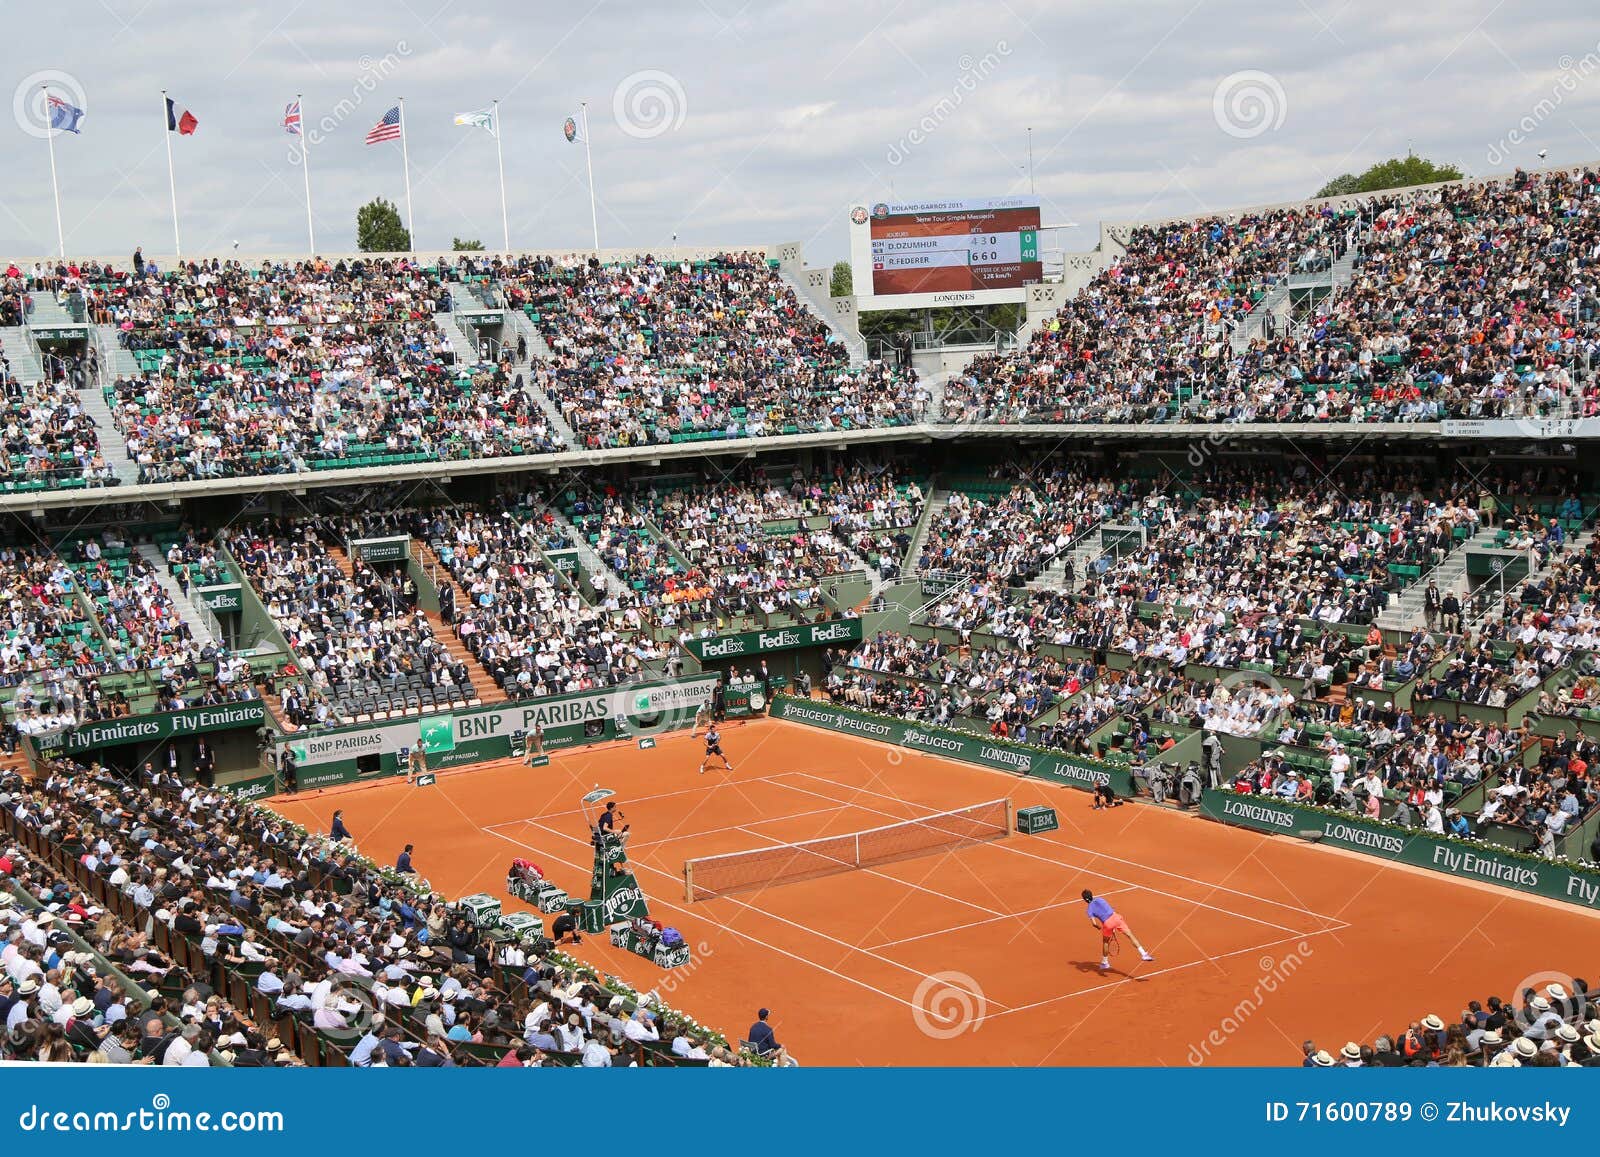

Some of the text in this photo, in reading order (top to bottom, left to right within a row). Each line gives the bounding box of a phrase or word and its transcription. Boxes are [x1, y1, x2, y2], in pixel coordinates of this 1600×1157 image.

[1025, 234, 1032, 243] 0
[889, 256, 929, 265] R.FEDERER
[972, 252, 978, 261] 6
[982, 252, 988, 260] 6
[991, 251, 997, 260] 0
[1022, 249, 1035, 258] 40
[934, 293, 975, 302] LONGINES
[702, 624, 852, 656] FedEx FedEx FedEx
[651, 691, 670, 702] BNP
[673, 685, 711, 699] PARIBAS
[727, 683, 761, 691] LONGINES
[172, 706, 264, 730] Fly Emirates
[459, 698, 608, 738] BNP PARIBAS
[40, 722, 159, 750] IBM Fly Emirates
[310, 742, 332, 754] BNP
[335, 734, 382, 749] PARIBAS
[790, 706, 1110, 786] PEUGEOT PEUGEOT PEUGEOT LONGINES LONGINES
[318, 773, 344, 783] PARIBAS
[238, 784, 267, 797] FedEx
[1033, 814, 1054, 827] IBM
[1224, 800, 1600, 904] LONGINES LONGINES Fly Emirates Fly
[606, 887, 642, 922] perrier
